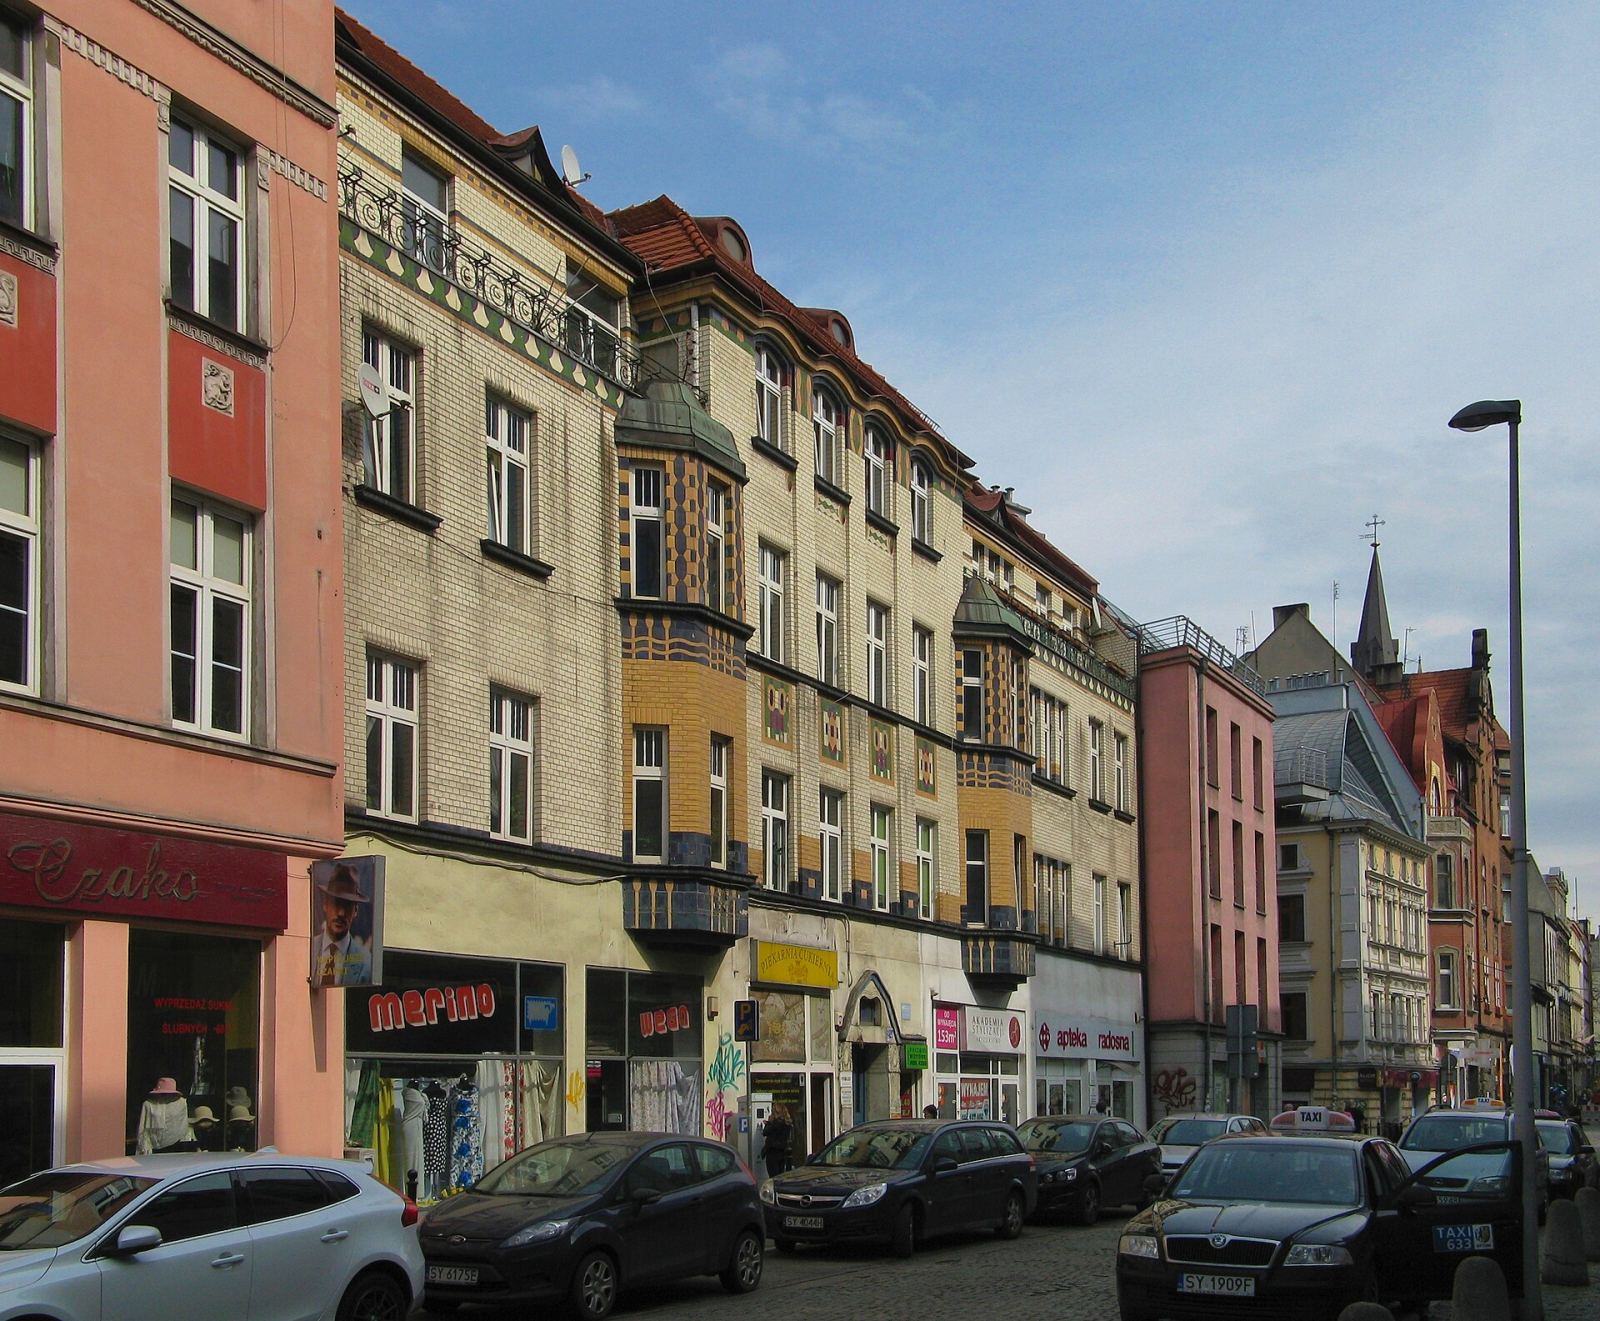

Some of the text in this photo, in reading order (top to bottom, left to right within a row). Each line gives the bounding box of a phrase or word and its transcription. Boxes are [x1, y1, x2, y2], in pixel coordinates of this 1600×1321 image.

[7, 837, 200, 904] Czako
[368, 982, 496, 1033] merino
[972, 1015, 1003, 1027] AKADEMIA
[1057, 1027, 1130, 1051] apteka radosna
[1300, 1111, 1322, 1122] TAXI
[741, 1118, 748, 1132] P
[1436, 1226, 1472, 1239] TAXI
[1447, 1238, 1472, 1250] 633
[430, 1267, 443, 1280] SY
[1185, 1275, 1252, 1292] SY 1909F
